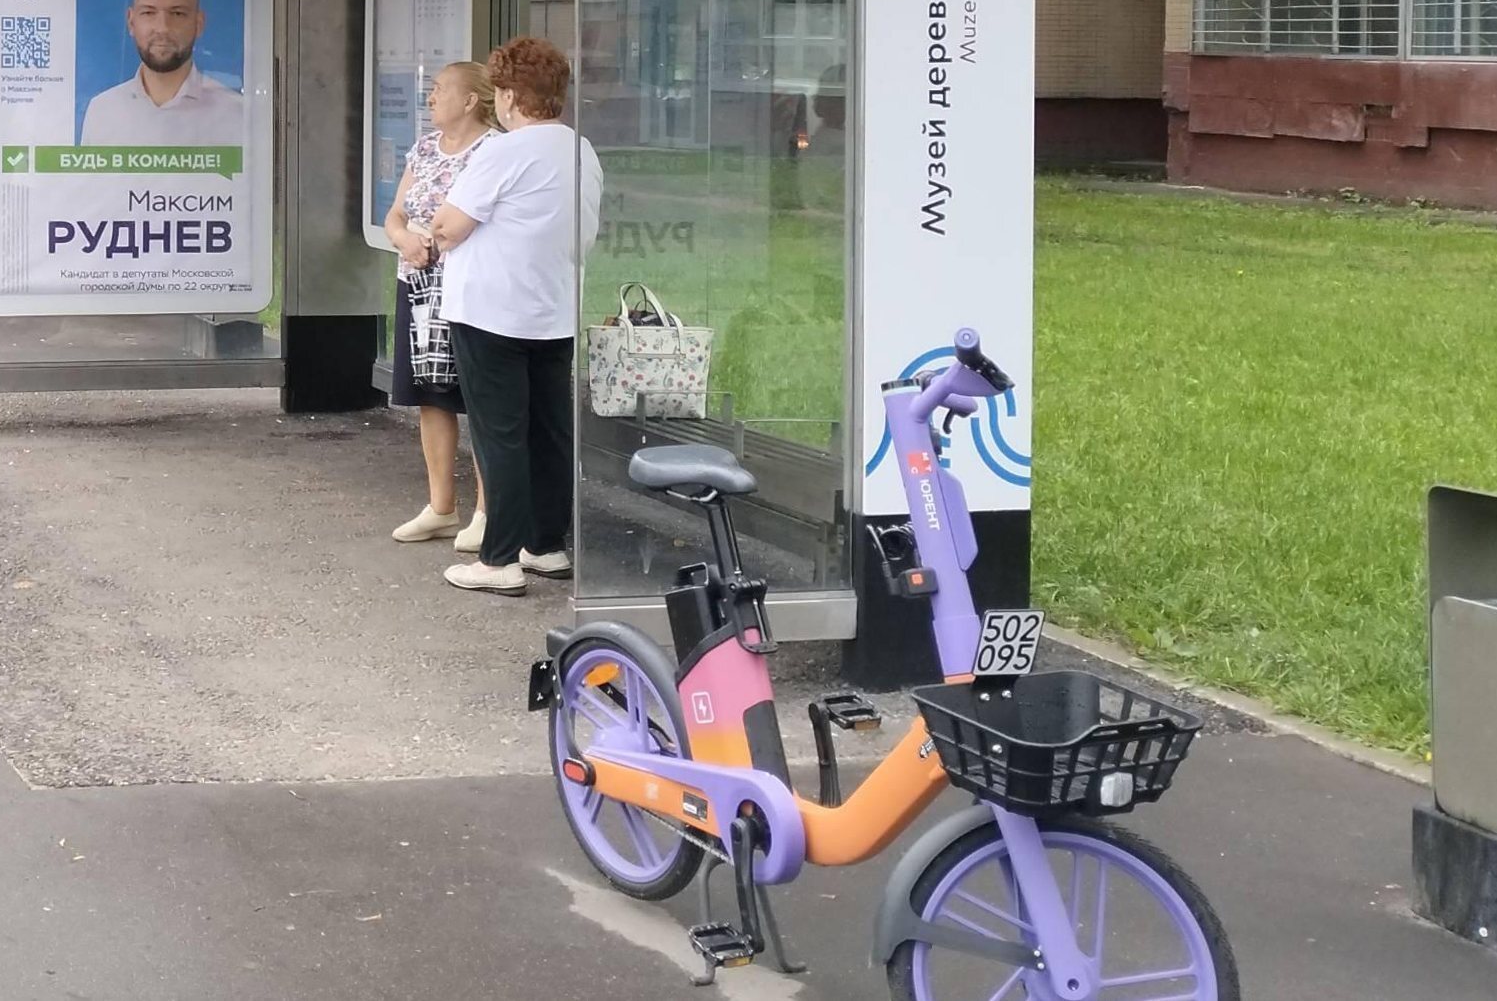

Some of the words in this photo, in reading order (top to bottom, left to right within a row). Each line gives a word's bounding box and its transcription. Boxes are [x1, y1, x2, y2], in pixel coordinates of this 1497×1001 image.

[60, 154, 108, 169] БУДЬ
[112, 154, 123, 167] В
[128, 154, 221, 169] КОМАНДЕ!
[921, 119, 952, 236] Музей
[128, 190, 233, 212] Максим
[48, 220, 233, 259] РУДНЕВ
[60, 270, 109, 279] Кандидат
[121, 270, 169, 280] депутаты
[172, 268, 234, 278] Московской
[80, 282, 135, 293] городской
[137, 282, 165, 292] Думы
[184, 282, 197, 291] 22
[920, 479, 940, 531] ЮРЕНТ
[983, 614, 1040, 643] 502
[977, 644, 1034, 672] 095
